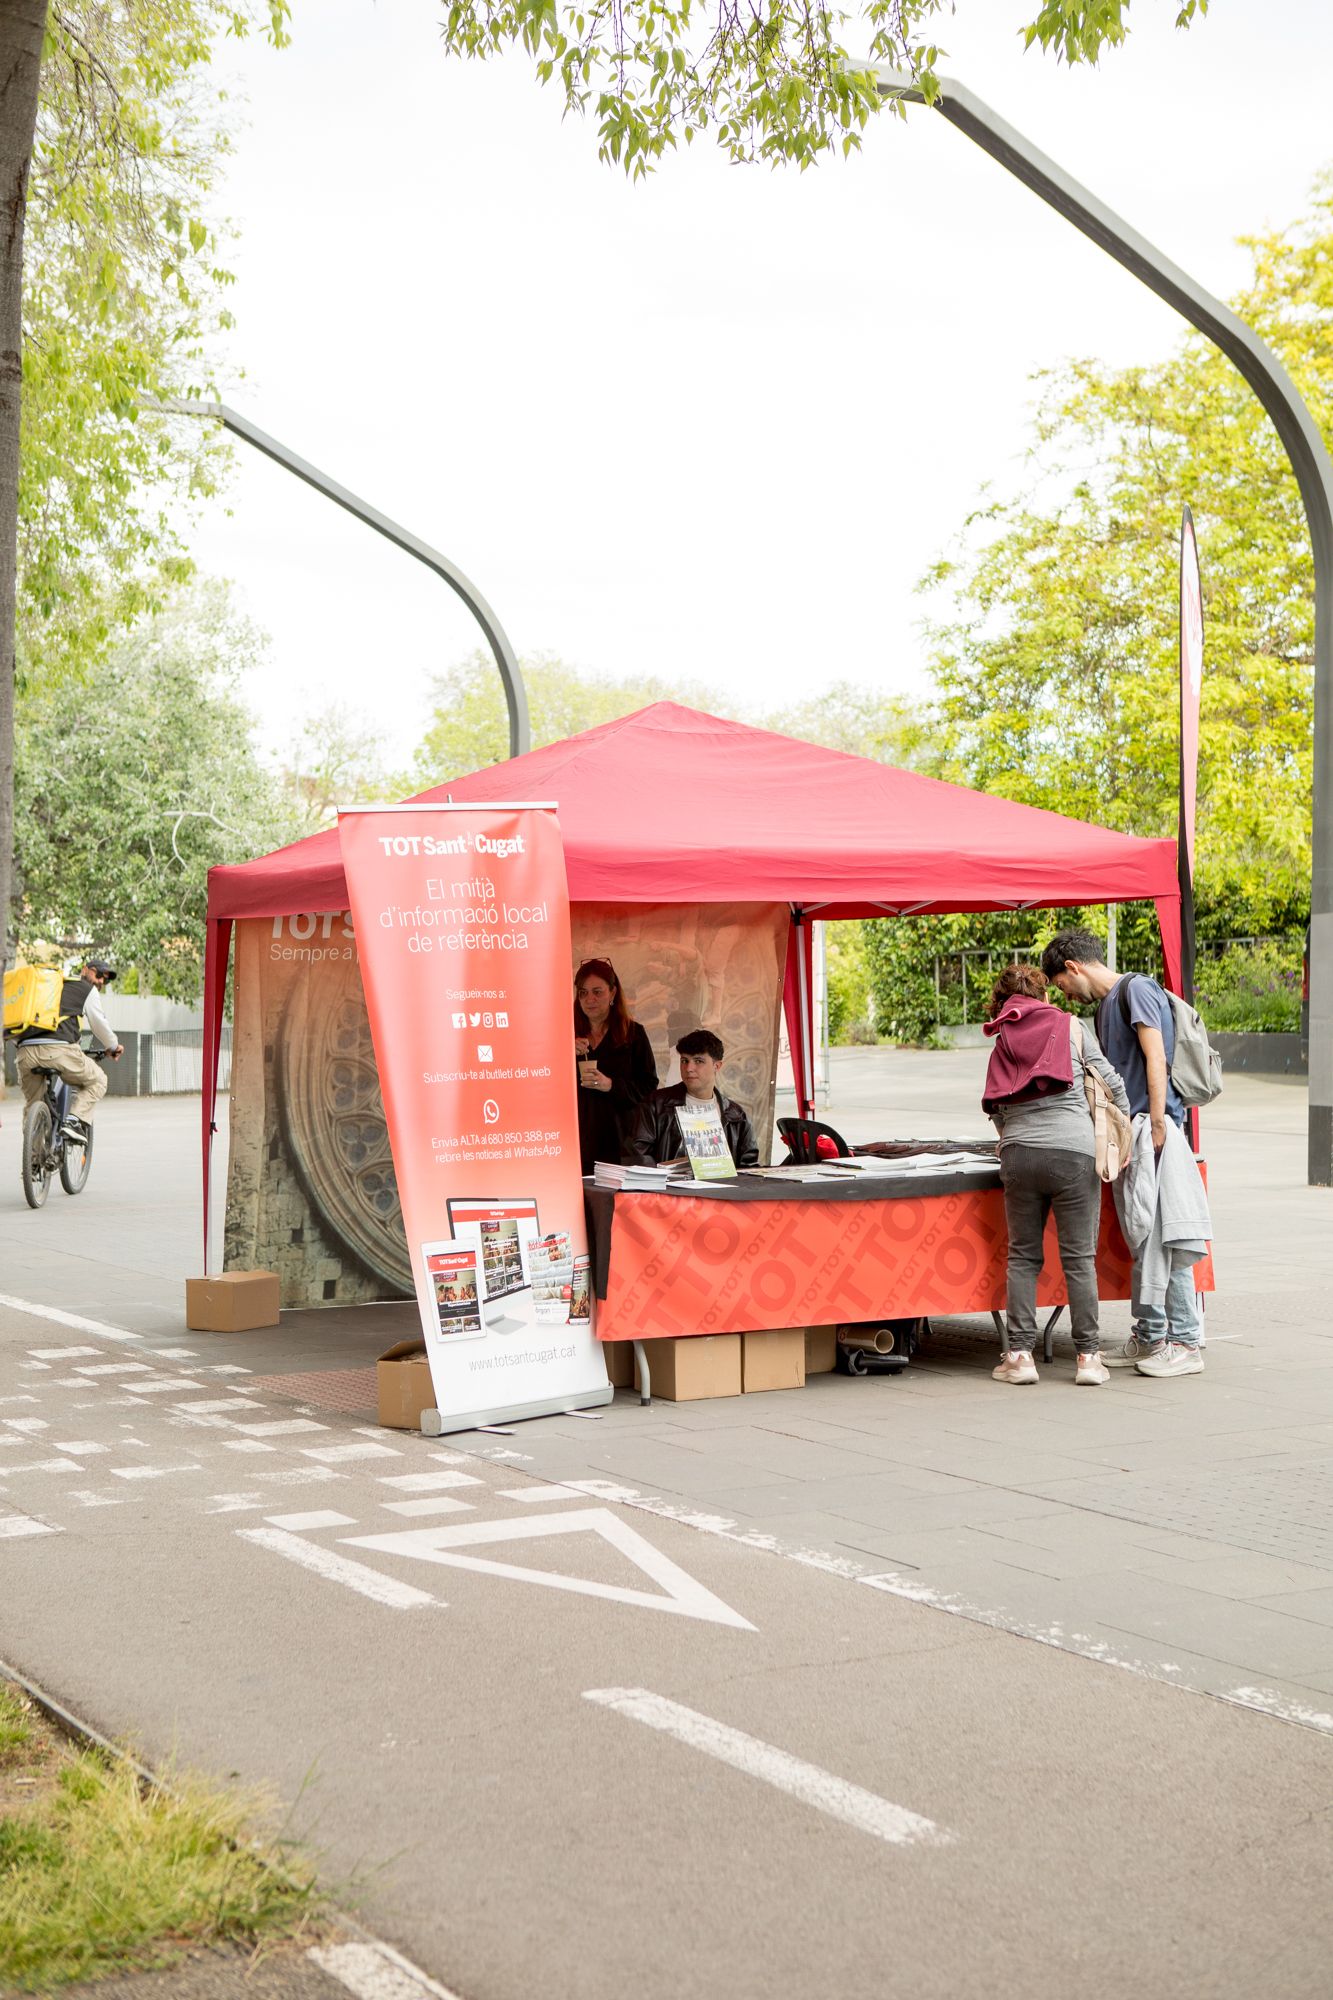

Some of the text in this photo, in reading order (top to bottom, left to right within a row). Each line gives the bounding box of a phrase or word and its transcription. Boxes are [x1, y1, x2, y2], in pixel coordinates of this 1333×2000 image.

[474, 833, 526, 858] Cugat
[426, 877, 495, 902] El mitjà
[379, 902, 548, 928] d'informació local
[407, 929, 529, 953] de referència
[270, 943, 339, 965] Sempre
[342, 948, 353, 960] a
[446, 988, 507, 1001] Segueix-nos a:
[423, 1070, 478, 1084] Subscriu-te
[479, 1069, 486, 1080] al
[514, 1067, 529, 1078] del
[531, 1066, 551, 1077] web
[431, 1137, 459, 1149] Envia
[460, 1134, 481, 1146] ALTA
[487, 1133, 503, 1145] 680
[504, 1132, 522, 1144] 850
[524, 1130, 543, 1142] 388
[544, 1130, 561, 1143] per
[435, 1152, 462, 1164] rebre
[463, 1150, 475, 1161] les
[504, 1148, 512, 1159] al
[514, 1145, 562, 1158] WhatsApp
[797, 1276, 823, 1310] TOT
[820, 1243, 845, 1276] TOT
[841, 1209, 866, 1242] TOT
[896, 1254, 920, 1287] TOT
[917, 1222, 941, 1254] TOT
[615, 1286, 640, 1321] TOT
[636, 1253, 665, 1286] TOT
[661, 1220, 687, 1252] TOT
[696, 1300, 722, 1332] TOT
[719, 1265, 743, 1299] TOT
[740, 1231, 765, 1264] TOT
[971, 1265, 997, 1298] TOT
[468, 1345, 577, 1373] www.totsantcugat.cat
